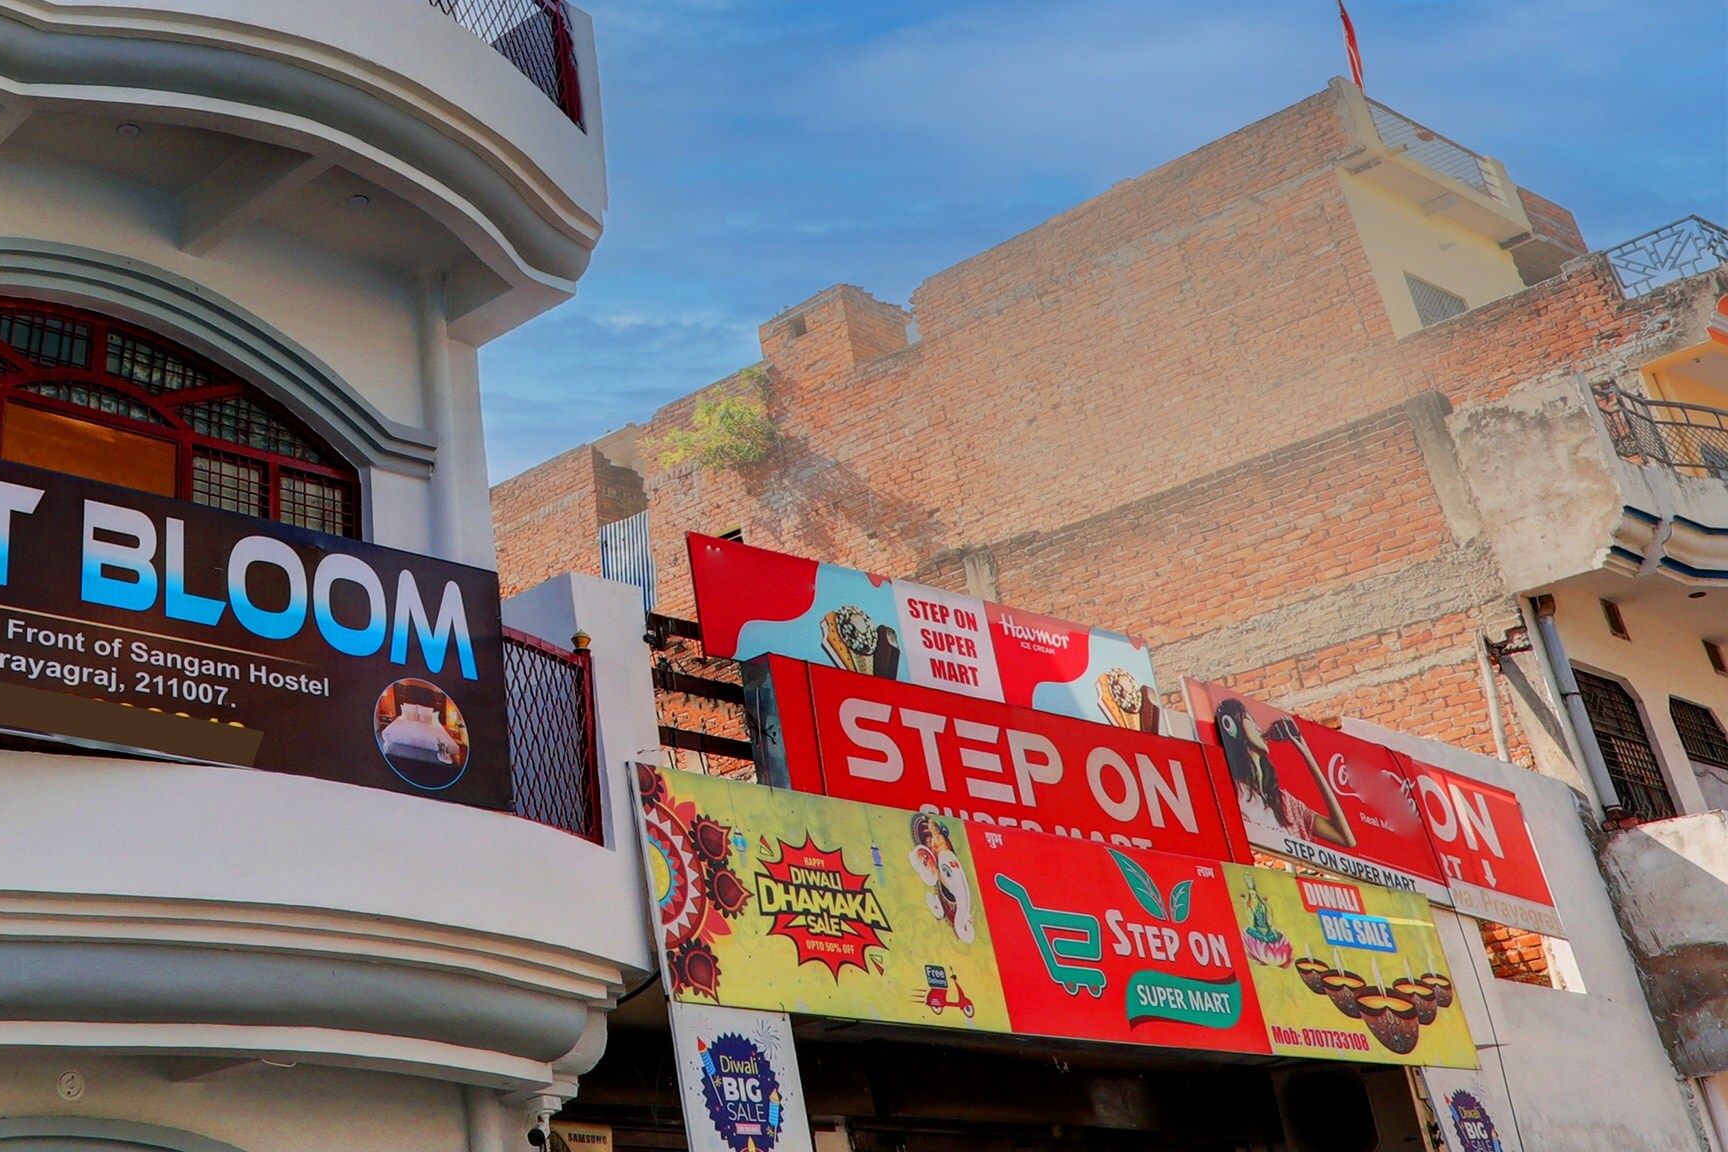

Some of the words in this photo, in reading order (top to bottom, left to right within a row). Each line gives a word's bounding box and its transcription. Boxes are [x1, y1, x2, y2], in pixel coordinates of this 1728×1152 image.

[80, 499, 479, 681] BLOOM
[907, 598, 949, 625] STEP
[953, 608, 979, 632] ON
[920, 628, 978, 659] SUPER
[999, 613, 1070, 649] Havmor
[6, 619, 86, 652] Front
[93, 638, 122, 660] of
[130, 642, 240, 680] Sangam
[249, 659, 330, 696] Hostel
[1020, 642, 1031, 650] ICE
[1033, 644, 1056, 655] CREAM
[929, 657, 979, 687] MART
[135, 673, 237, 709] 211007.
[838, 697, 1064, 807] STEP
[1085, 746, 1200, 834] ON
[1416, 774, 1504, 859] ON
[789, 866, 843, 890] DIWALI
[1284, 838, 1315, 860] STEP
[1318, 850, 1338, 870] ON
[1340, 857, 1381, 884] SUPER
[1382, 870, 1417, 892] MART
[757, 875, 890, 929] DHAMAKA
[1302, 882, 1361, 913] DIWALI
[806, 912, 843, 937] SALE
[1320, 914, 1352, 943] BIG
[1352, 918, 1393, 948] SALE
[1188, 931, 1232, 968] ON
[926, 966, 945, 979] Free
[1136, 984, 1187, 1010] SUPER
[1187, 990, 1231, 1014] MART
[1272, 1026, 1302, 1046] Mob:
[719, 1055, 758, 1074] Diwali
[722, 1077, 763, 1102] BIG
[726, 1102, 766, 1122] SALE
[568, 1133, 608, 1145] SAMSUNG
